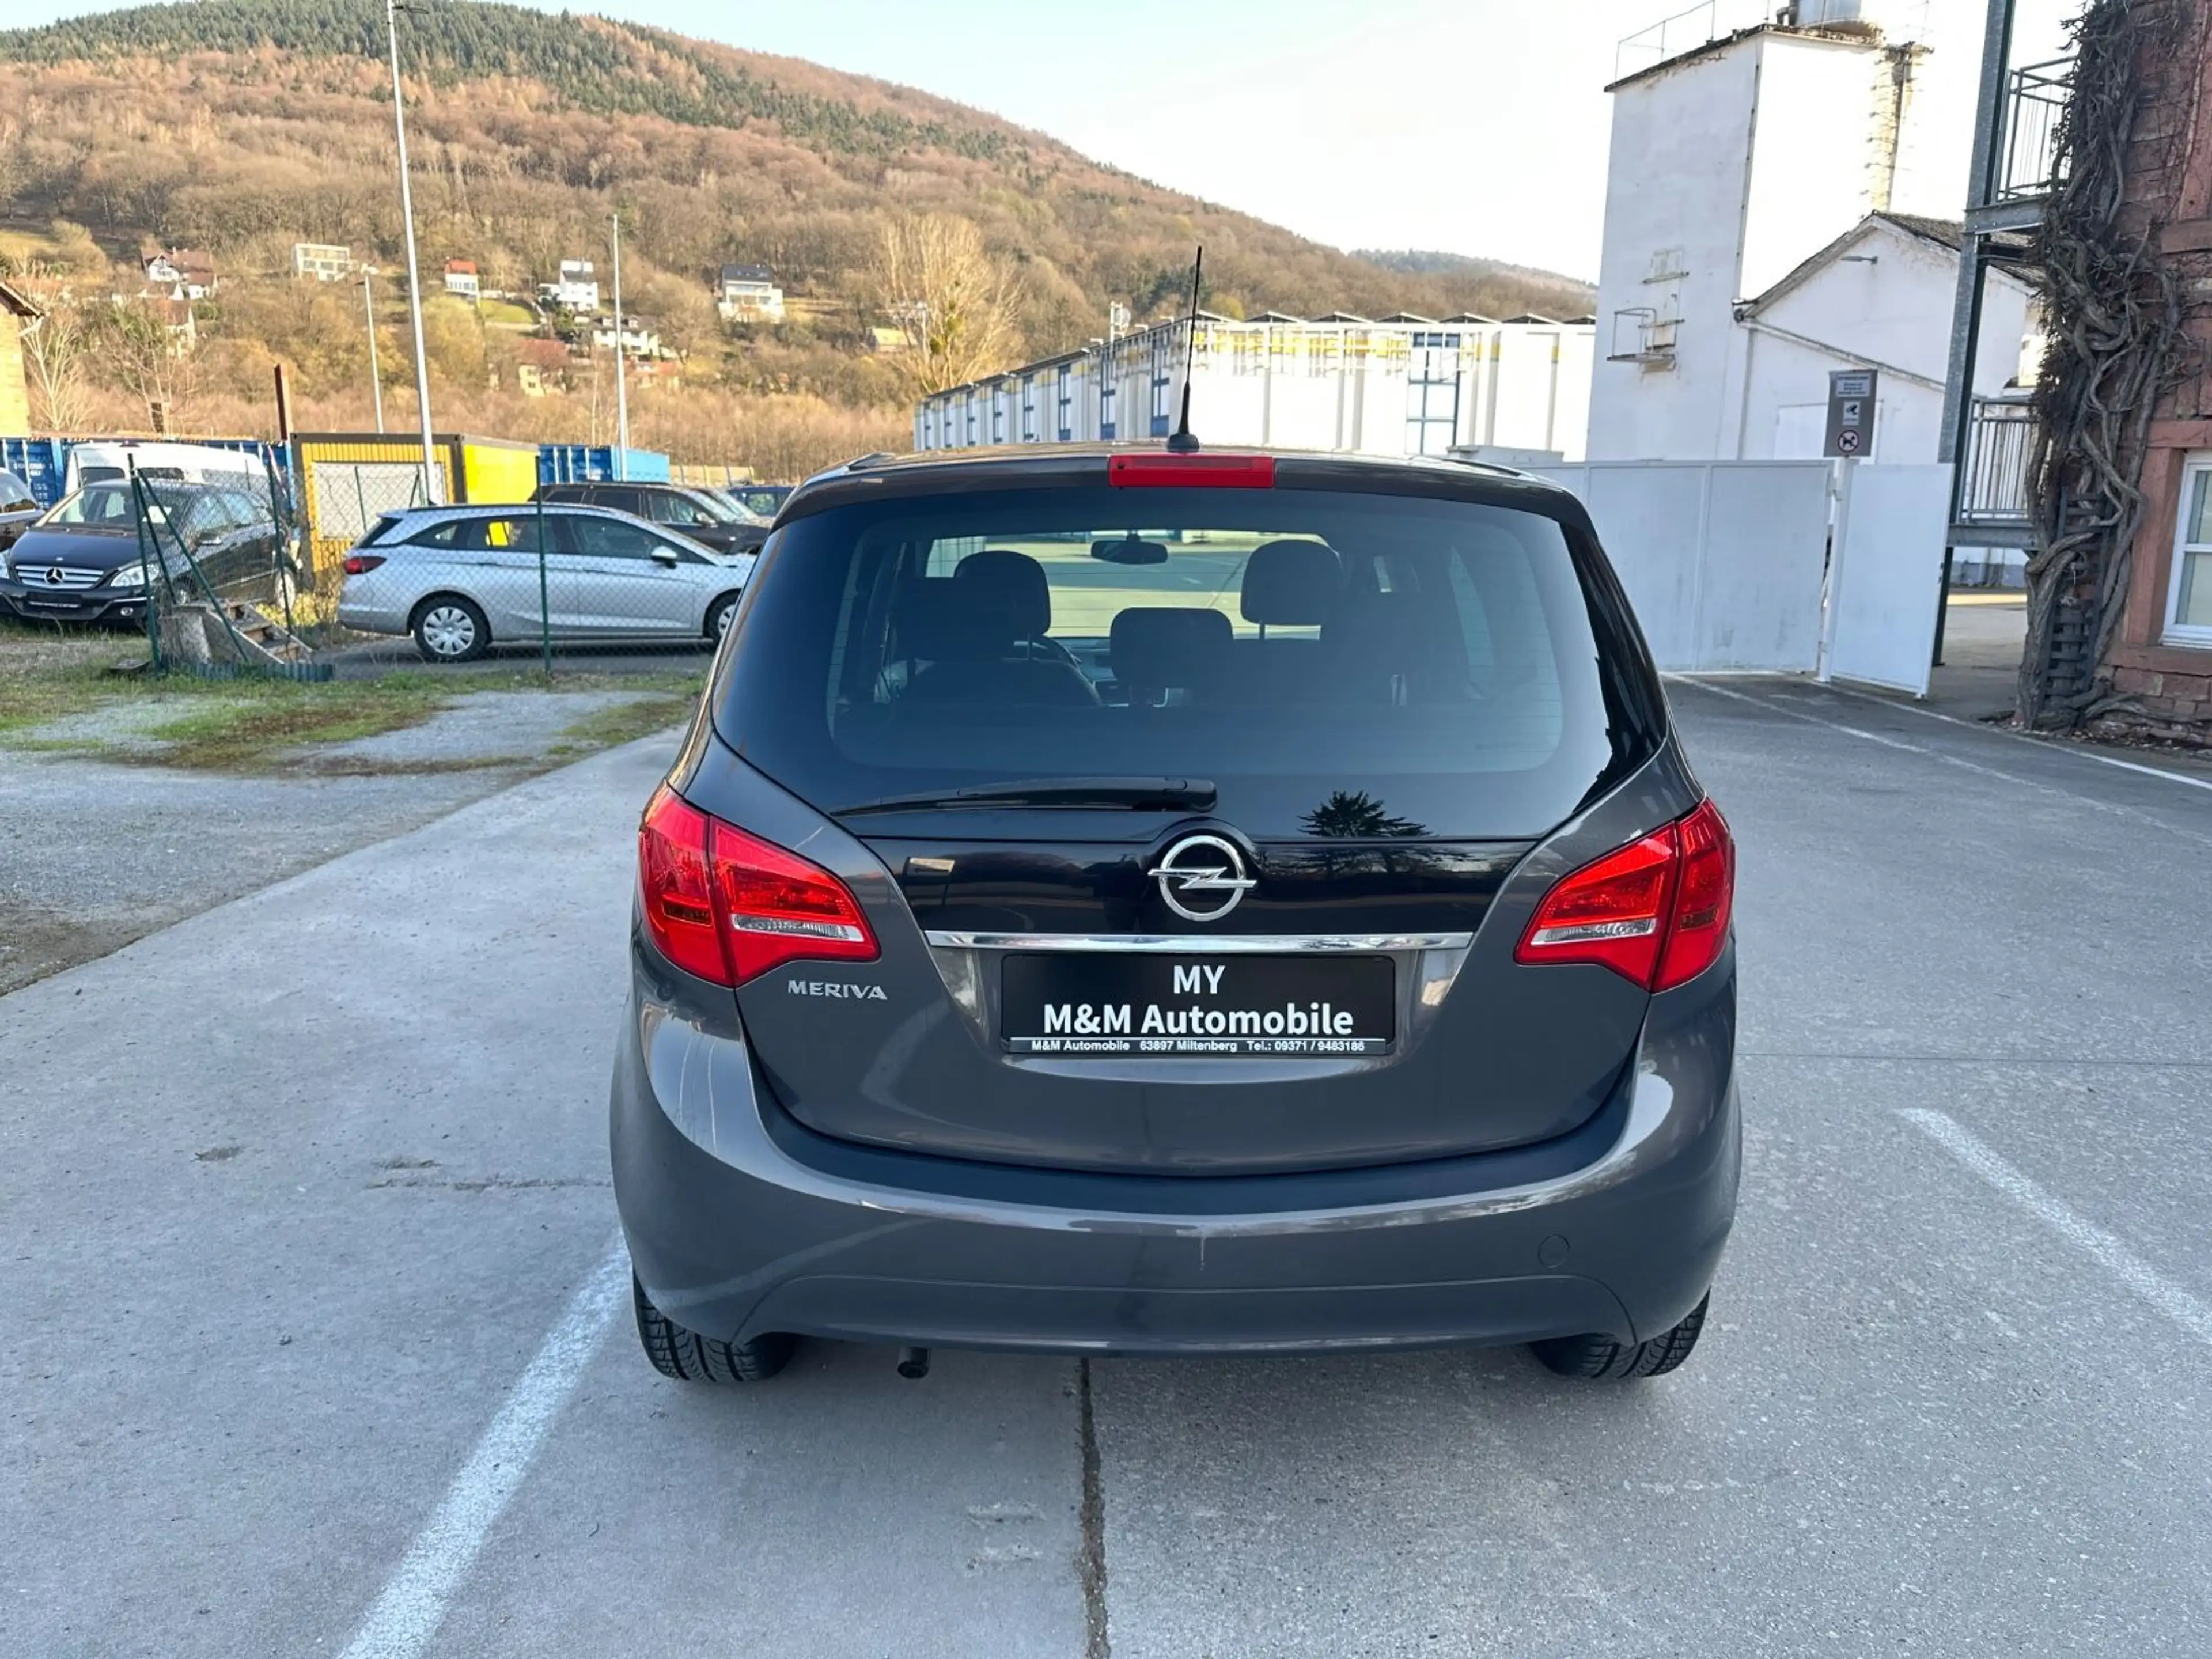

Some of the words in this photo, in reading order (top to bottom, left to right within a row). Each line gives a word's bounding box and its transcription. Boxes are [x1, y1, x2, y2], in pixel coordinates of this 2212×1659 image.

[787, 980, 888, 1000] MERIVA
[1173, 965, 1226, 994] MY
[1043, 1003, 1131, 1034] M&M
[1140, 1002, 1353, 1035] Automobile
[1031, 1040, 1060, 1051] M&M
[1063, 1040, 1130, 1051] Automobile
[1139, 1041, 1173, 1051] 63897
[1176, 1040, 1237, 1053] Miltenberg
[1247, 1040, 1271, 1051] Tel.:
[1274, 1041, 1307, 1051] 09371
